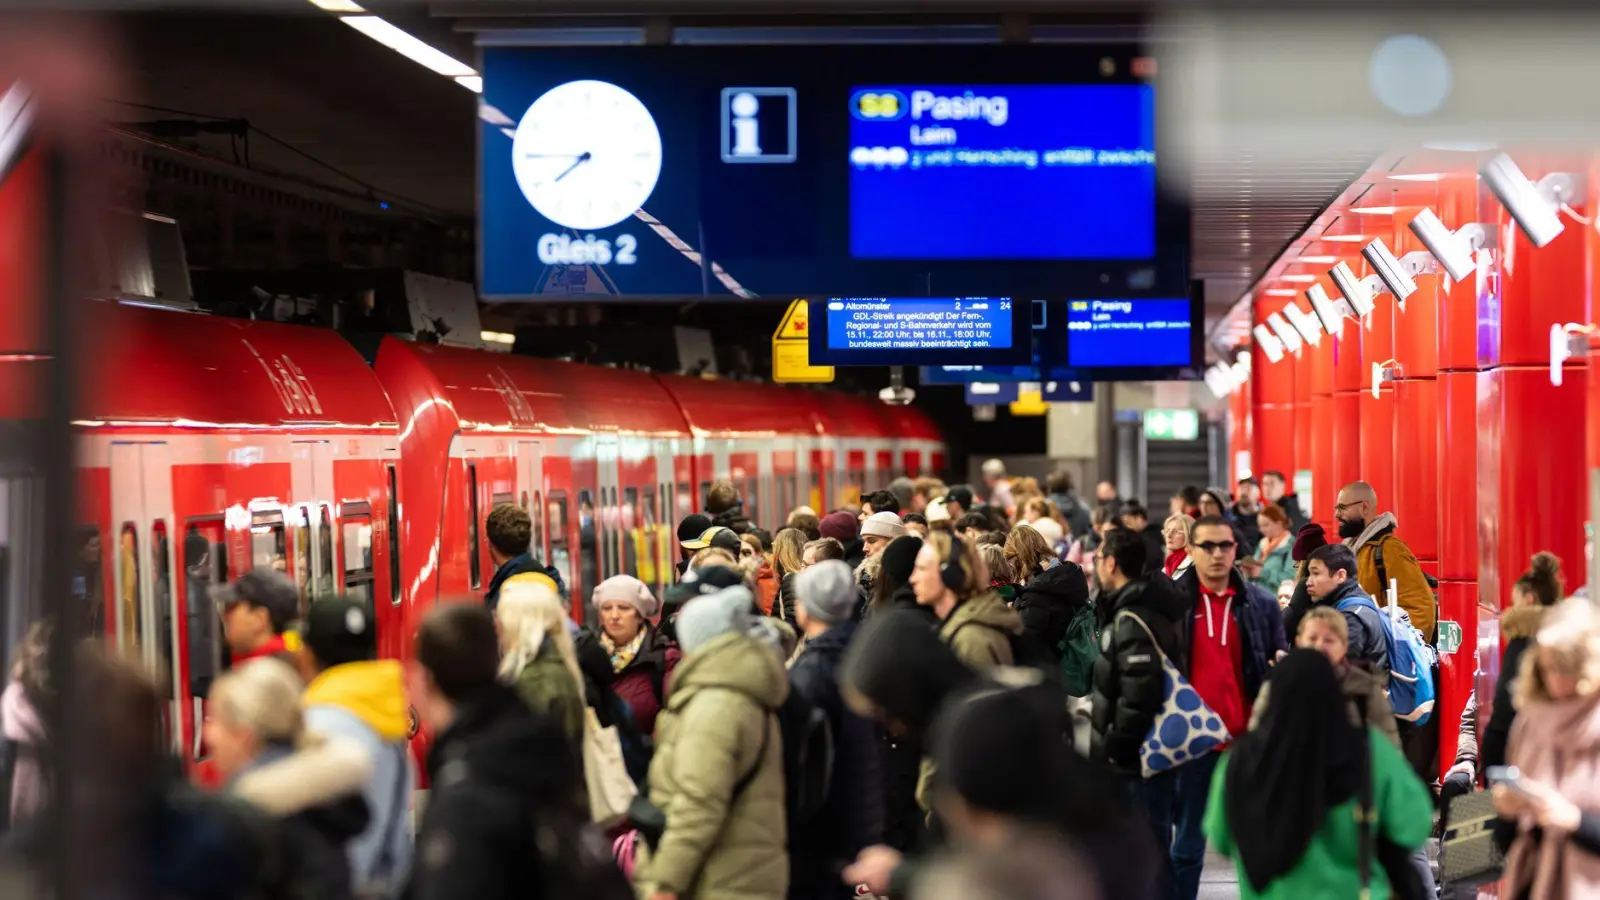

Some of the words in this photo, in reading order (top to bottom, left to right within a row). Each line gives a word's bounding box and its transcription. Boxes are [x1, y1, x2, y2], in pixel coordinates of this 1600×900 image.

[911, 90, 1009, 126] Pasing
[910, 124, 957, 146] Laim
[537, 233, 613, 265] Gleis
[615, 233, 638, 265] 2
[845, 302, 891, 310] Altomünster
[955, 302, 961, 310] 2
[1000, 302, 1011, 310] 24
[1092, 300, 1132, 313] Pasing
[853, 312, 895, 320] GDL-Streik
[896, 312, 944, 322] angekündigt!
[946, 312, 960, 320] Der
[961, 312, 984, 320] Fern-,
[846, 321, 882, 331] Regional-
[884, 321, 899, 329] und
[900, 321, 956, 329] S-Bahnverkehr
[957, 321, 973, 329] wird
[846, 331, 871, 339] 15.11.,
[872, 330, 894, 338] 22:00
[913, 330, 925, 338] bis
[976, 330, 992, 339] Uhr,
[849, 340, 892, 348] bundesweit
[893, 340, 920, 348] massiv
[921, 340, 972, 349] beeinträchtigt
